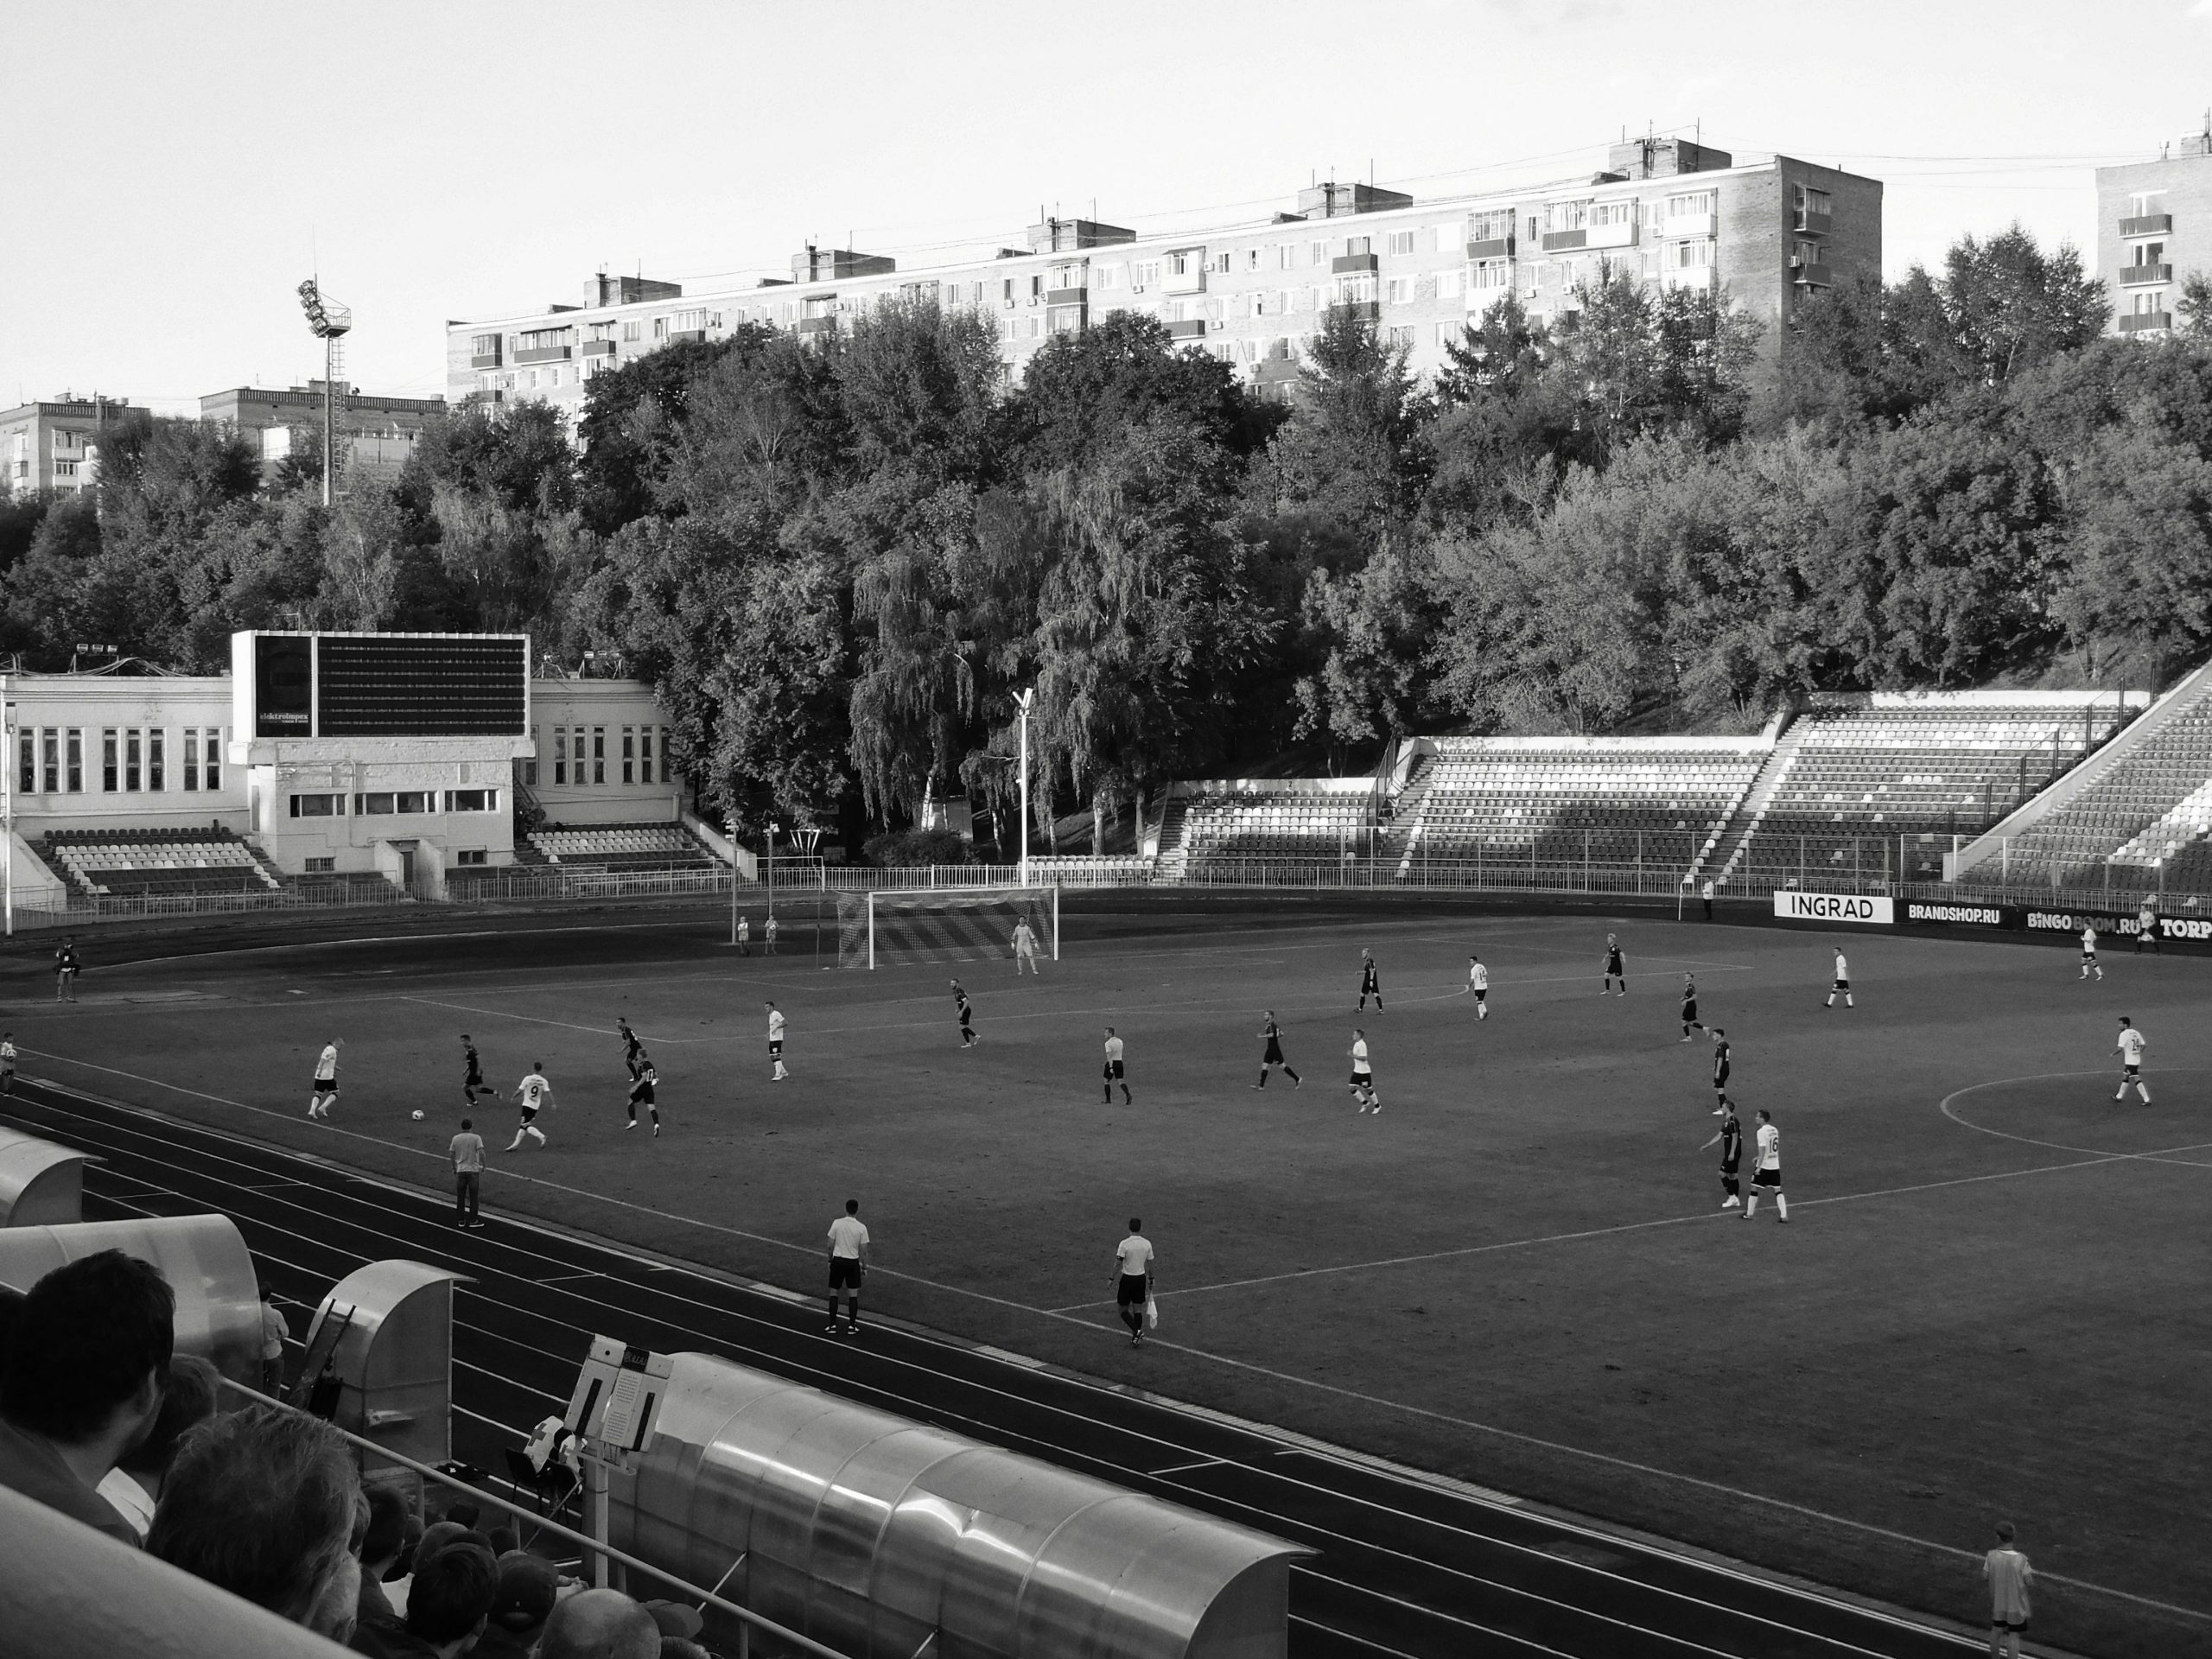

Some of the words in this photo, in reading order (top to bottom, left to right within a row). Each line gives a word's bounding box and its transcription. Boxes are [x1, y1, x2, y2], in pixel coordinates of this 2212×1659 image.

[1791, 895, 1873, 918] INGRAD
[1909, 905, 1999, 924] BRANDSHOP.RU
[531, 1085, 538, 1097] 9
[1769, 1137, 1778, 1152] 16
